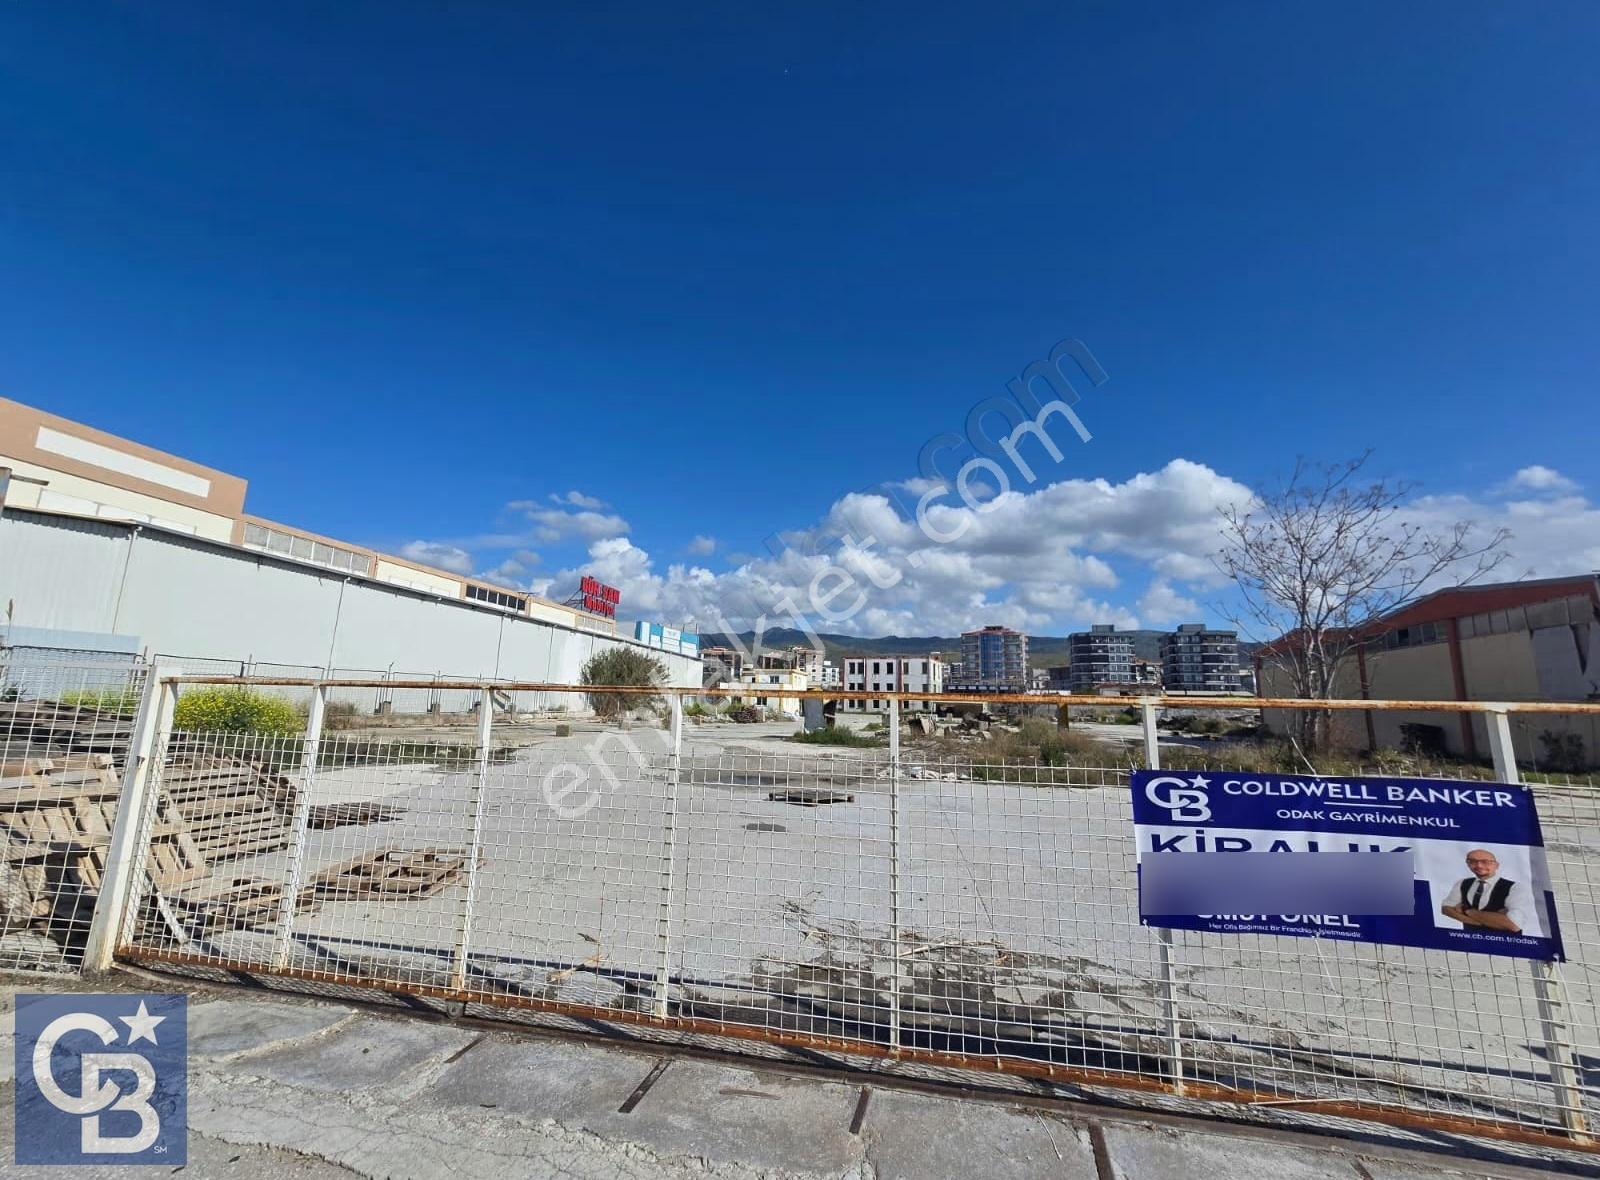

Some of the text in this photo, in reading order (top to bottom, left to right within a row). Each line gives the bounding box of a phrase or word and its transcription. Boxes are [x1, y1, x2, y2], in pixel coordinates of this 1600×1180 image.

[1223, 780, 1517, 807] COLDWELL BANKER
[1276, 809, 1461, 828] ODAK GAYRİMENKUL
